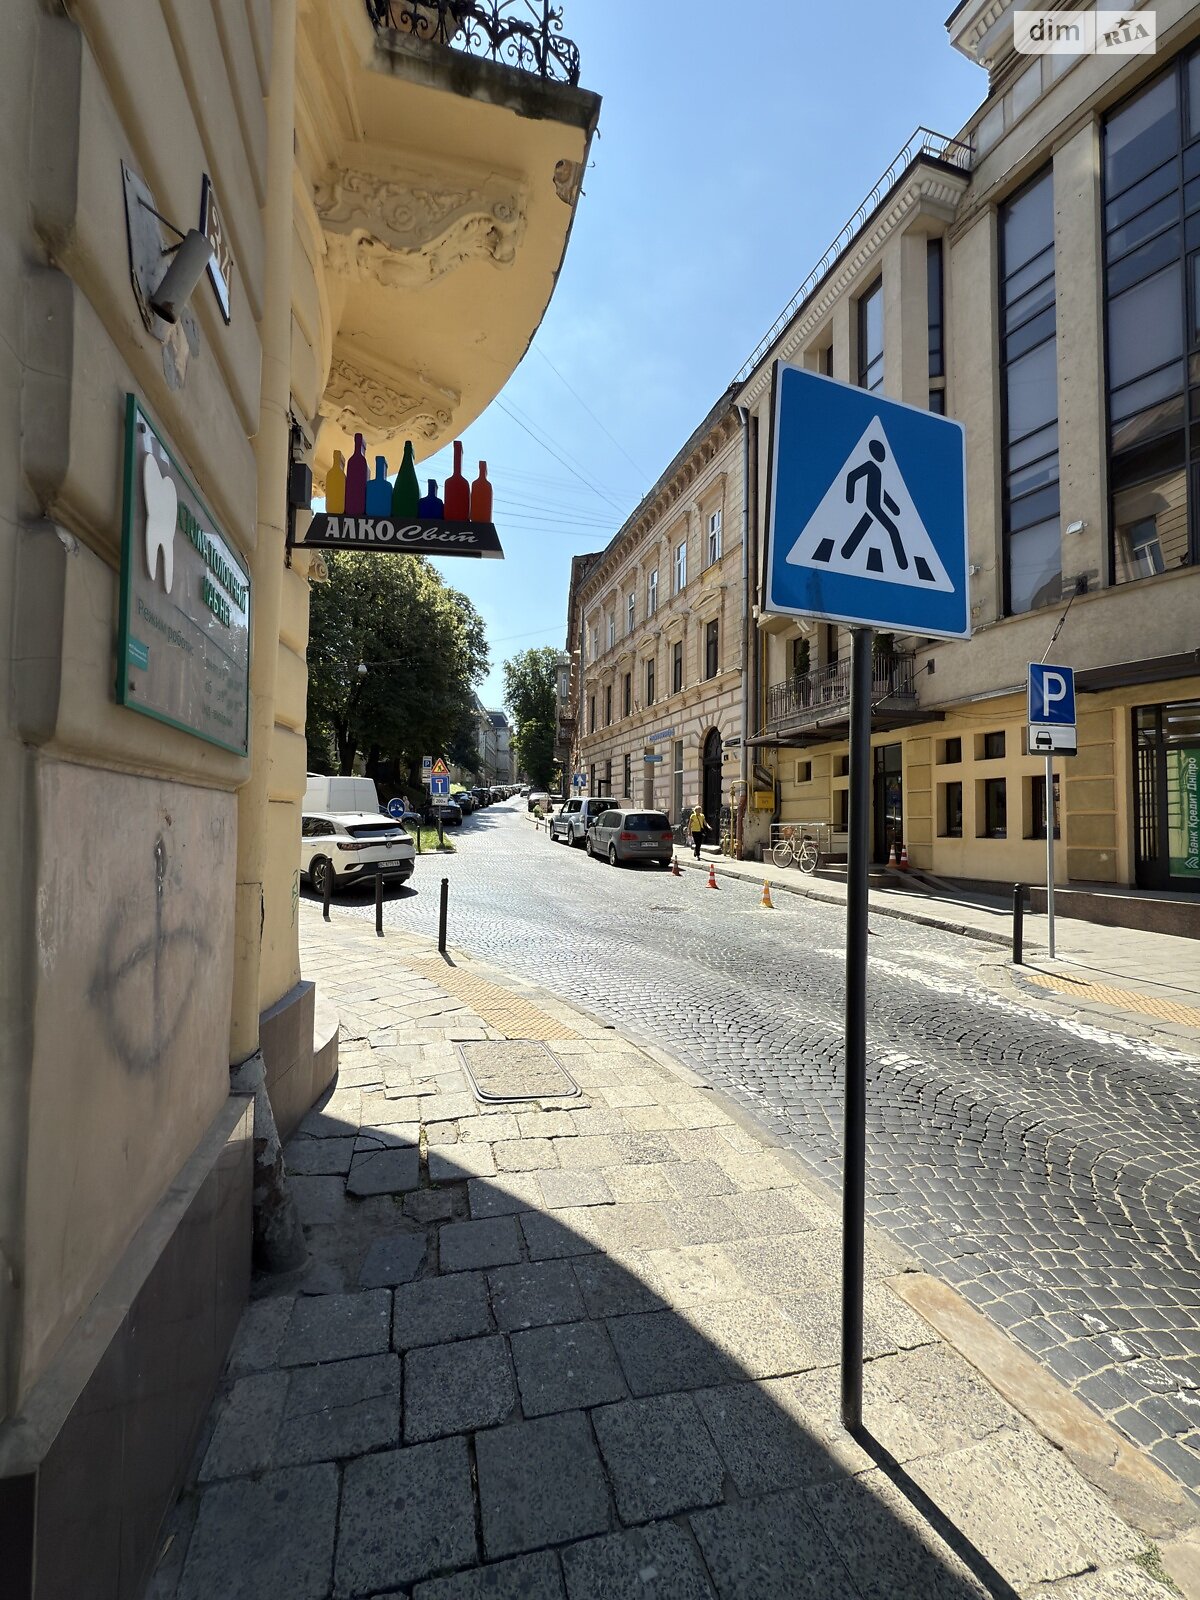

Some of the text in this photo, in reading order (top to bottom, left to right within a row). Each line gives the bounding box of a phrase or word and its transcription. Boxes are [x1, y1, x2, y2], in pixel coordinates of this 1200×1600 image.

[1042, 671, 1067, 717] P
[1187, 757, 1200, 854] Банк Кредит Дніпро
